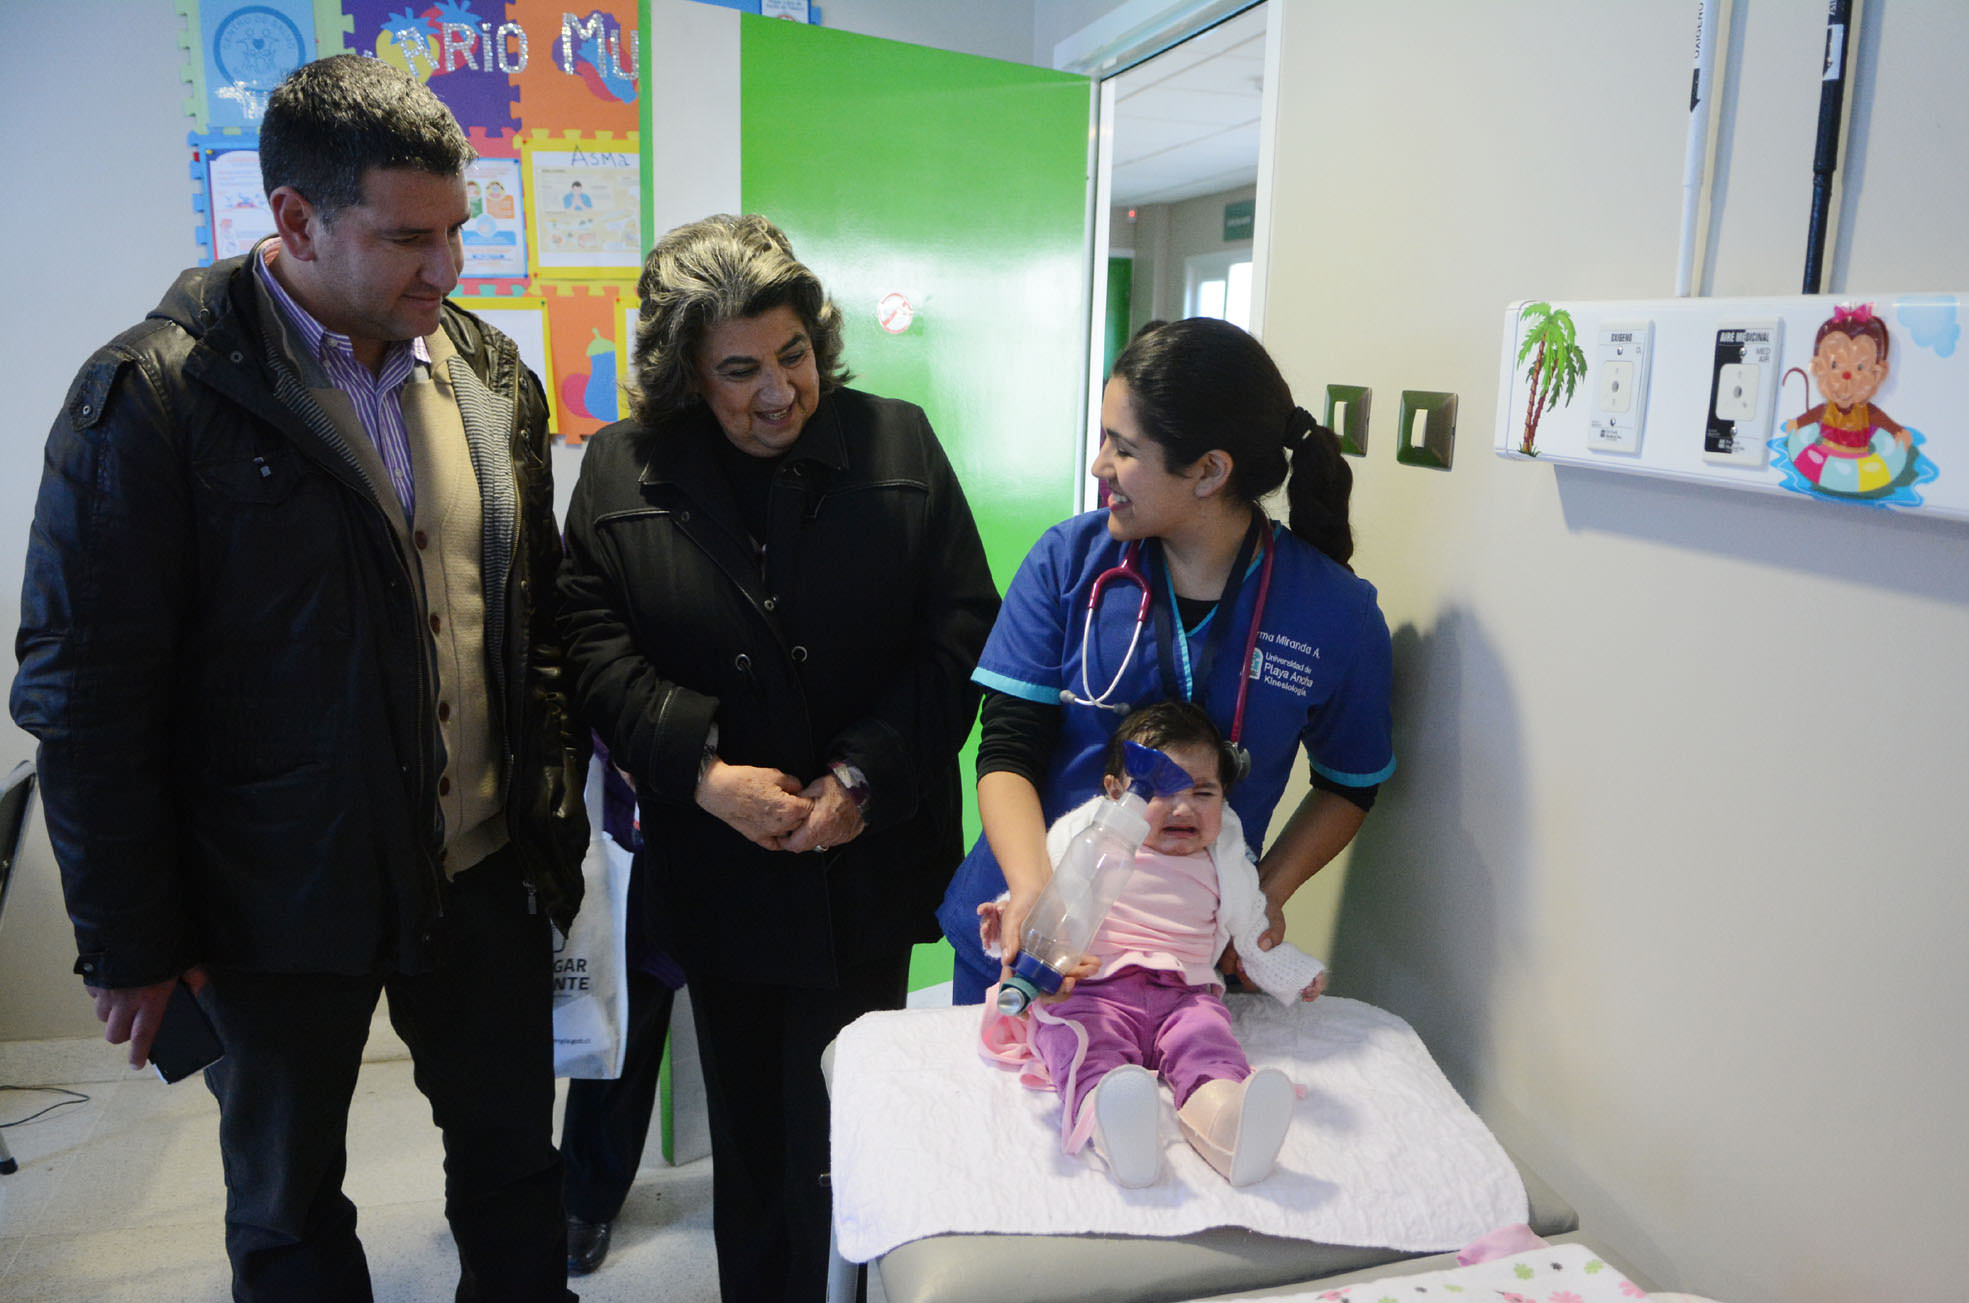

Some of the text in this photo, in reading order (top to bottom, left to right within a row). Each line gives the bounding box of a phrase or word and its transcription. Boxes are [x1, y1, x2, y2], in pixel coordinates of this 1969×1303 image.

[1256, 631, 1275, 642] ma
[1276, 634, 1312, 655] Miranda
[1265, 651, 1304, 671] Universidad
[1264, 661, 1314, 688] Playa Ancha
